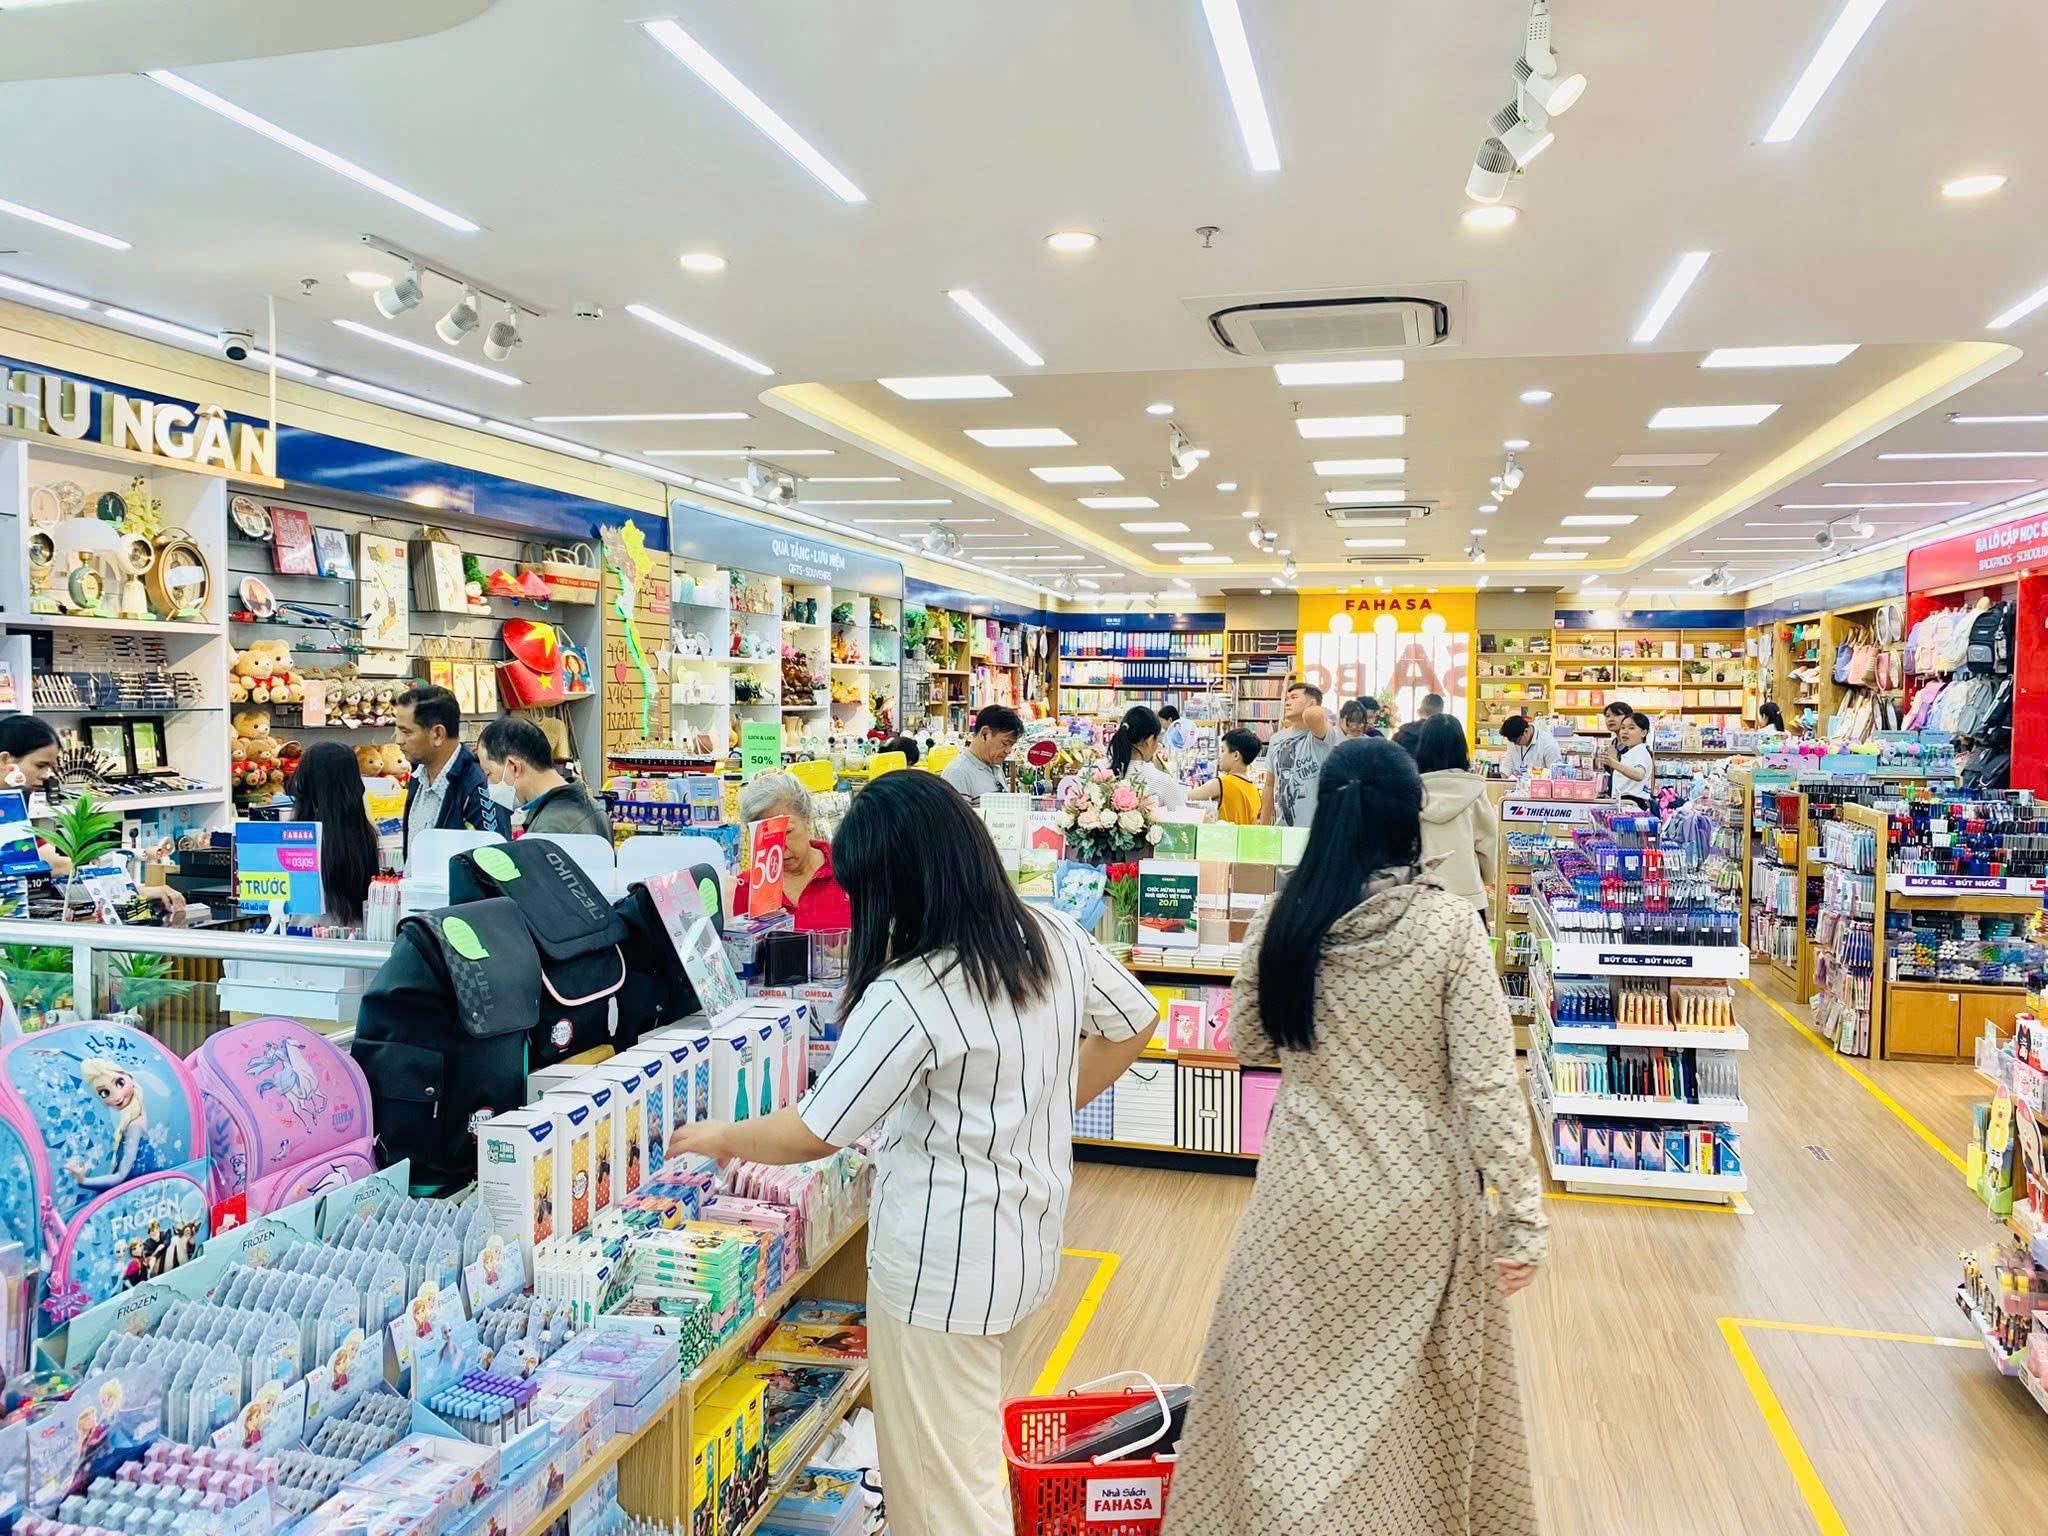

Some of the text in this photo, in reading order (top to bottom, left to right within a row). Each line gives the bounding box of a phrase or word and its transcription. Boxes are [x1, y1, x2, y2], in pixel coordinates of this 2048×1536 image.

[110, 393, 277, 477] NGÂN
[1345, 598, 1432, 611] FAHASA
[750, 755, 773, 765] 50%
[245, 877, 287, 895] TRƯỚC
[1911, 877, 1929, 886] BÚT
[1956, 878, 1973, 887] BÚT
[1604, 955, 1620, 963] BÚT
[1645, 956, 1661, 964] BÚT
[804, 990, 832, 998] OMEGA
[85, 1035, 128, 1054] ELSA
[111, 1193, 180, 1241] FROZEN
[242, 1229, 275, 1251] FROZEN
[117, 1292, 158, 1320] FROZEN
[1102, 1487, 1146, 1498] Nhà Sách
[1094, 1498, 1152, 1512] FAHASA
